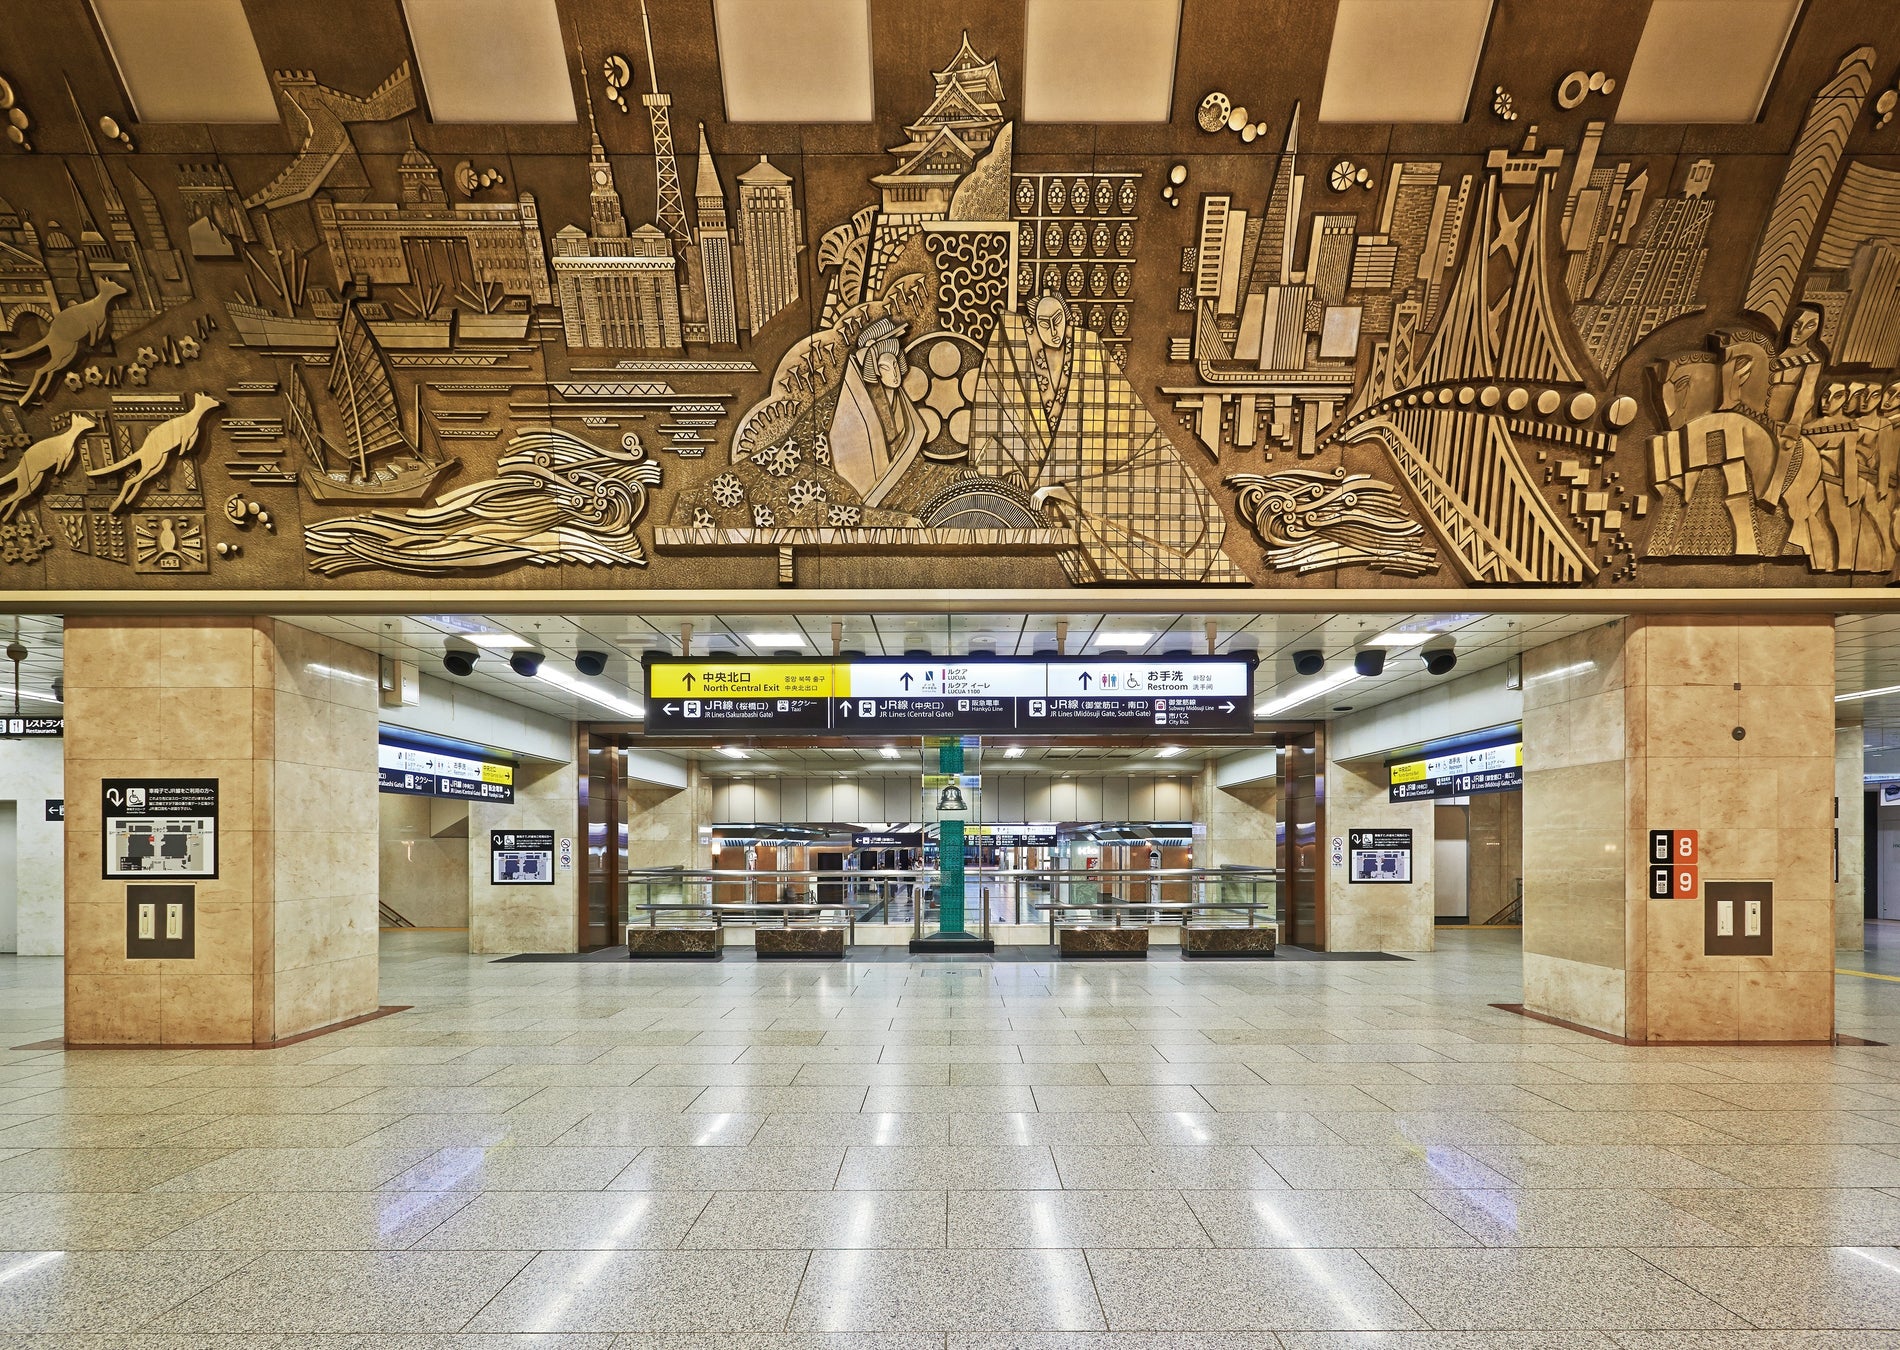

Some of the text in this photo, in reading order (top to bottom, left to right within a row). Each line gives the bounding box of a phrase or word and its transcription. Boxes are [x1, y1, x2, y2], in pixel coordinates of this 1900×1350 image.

[703, 672, 751, 682] 中央北口
[1148, 671, 1183, 681] お手洗
[415, 775, 433, 784] タクシー
[1680, 838, 1692, 856] 8
[1680, 872, 1692, 891] 9
